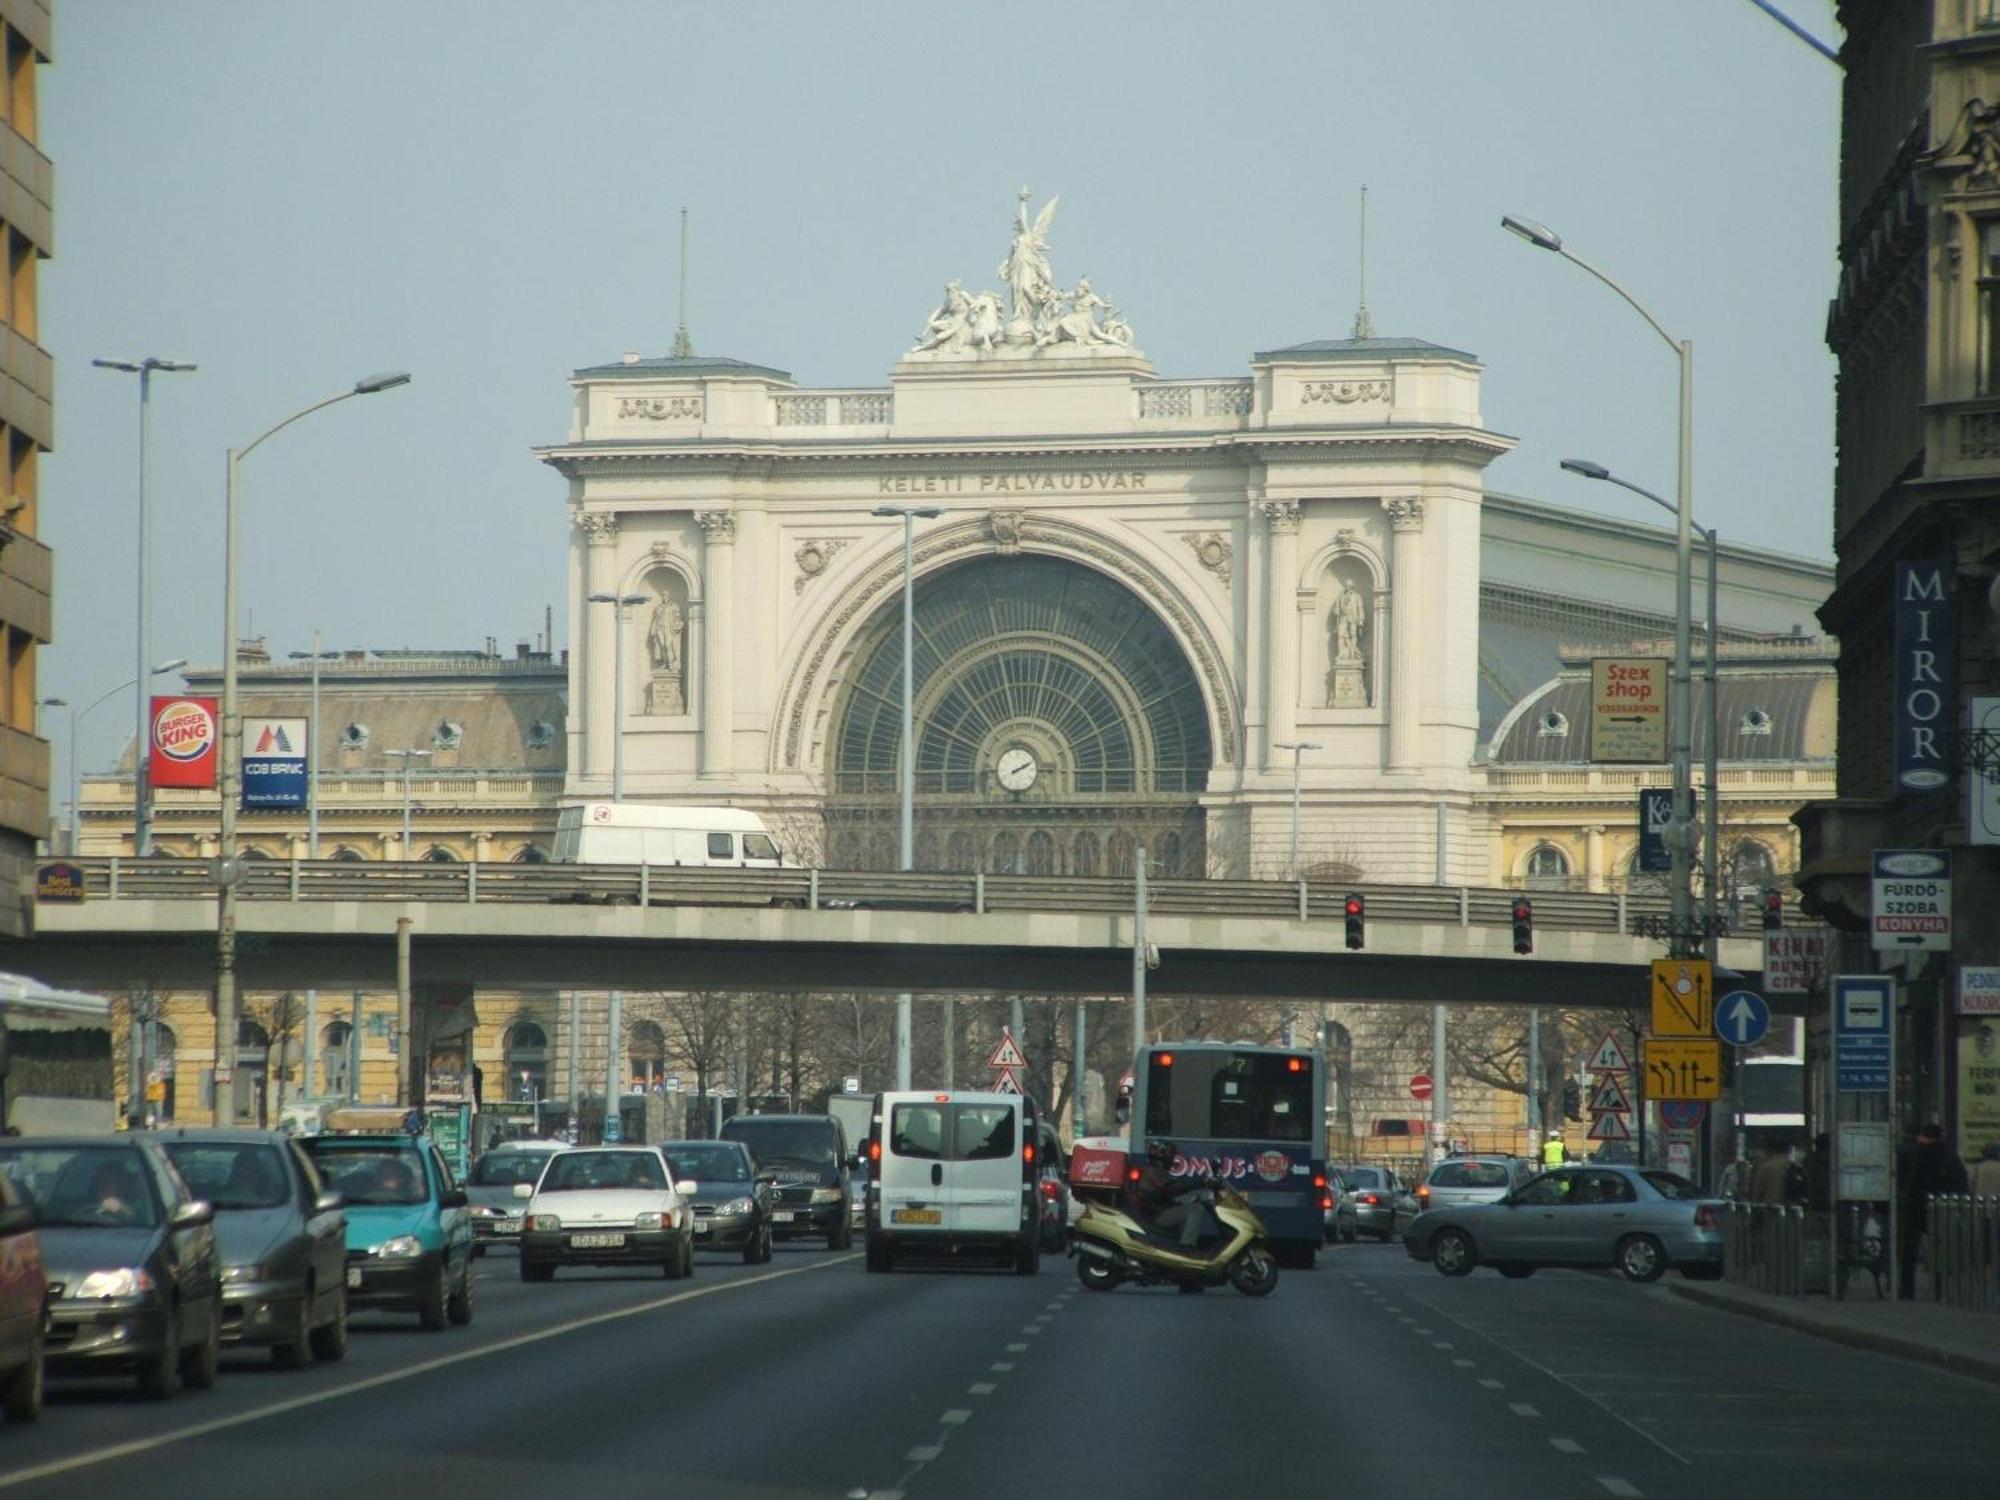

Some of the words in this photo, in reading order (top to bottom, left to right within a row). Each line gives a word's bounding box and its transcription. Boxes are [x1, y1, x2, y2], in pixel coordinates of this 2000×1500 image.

[878, 477, 962, 493] KELETI
[1607, 663, 1650, 680] Szex
[1903, 569, 1946, 759] MIROR
[1605, 681, 1652, 702] shop
[160, 713, 205, 734] BURGER
[162, 724, 207, 748] KING
[48, 875, 71, 888] Best
[1885, 902, 1938, 914] SZOBA
[1879, 918, 1946, 931] KONYHA
